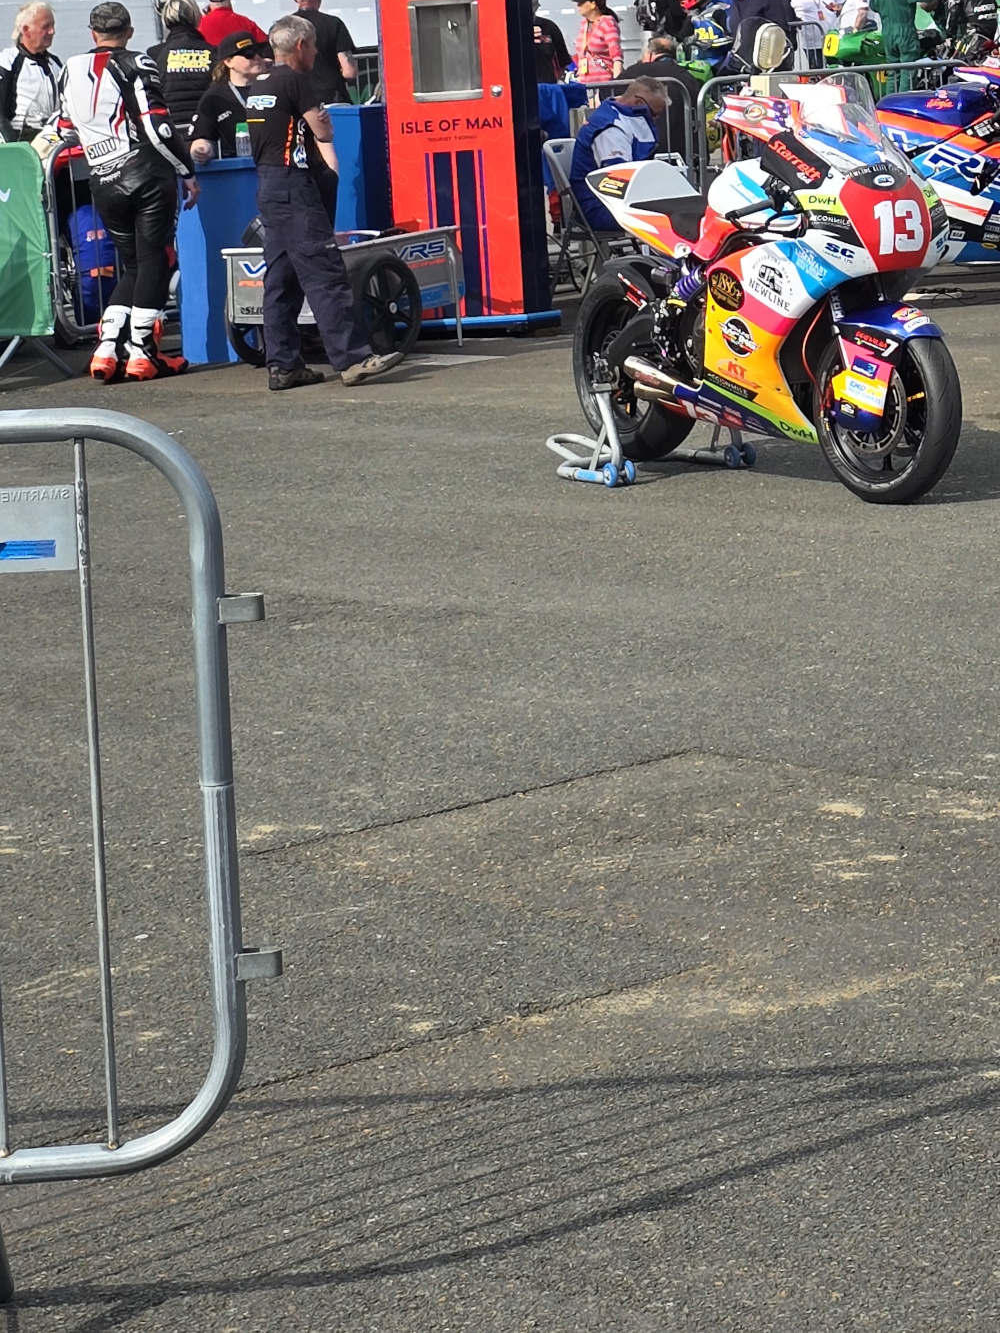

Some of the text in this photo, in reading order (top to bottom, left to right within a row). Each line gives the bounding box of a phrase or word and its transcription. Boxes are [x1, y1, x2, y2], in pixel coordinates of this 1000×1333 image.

[401, 116, 503, 134] ISLE OF MAN
[768, 139, 821, 182] Starrett
[808, 195, 837, 206] DwH
[874, 199, 925, 256] 13
[393, 237, 447, 261] VRS
[824, 242, 856, 259] SC
[749, 277, 791, 313] NEWLINE
[727, 360, 748, 380] KT
[779, 420, 815, 441] DwH
